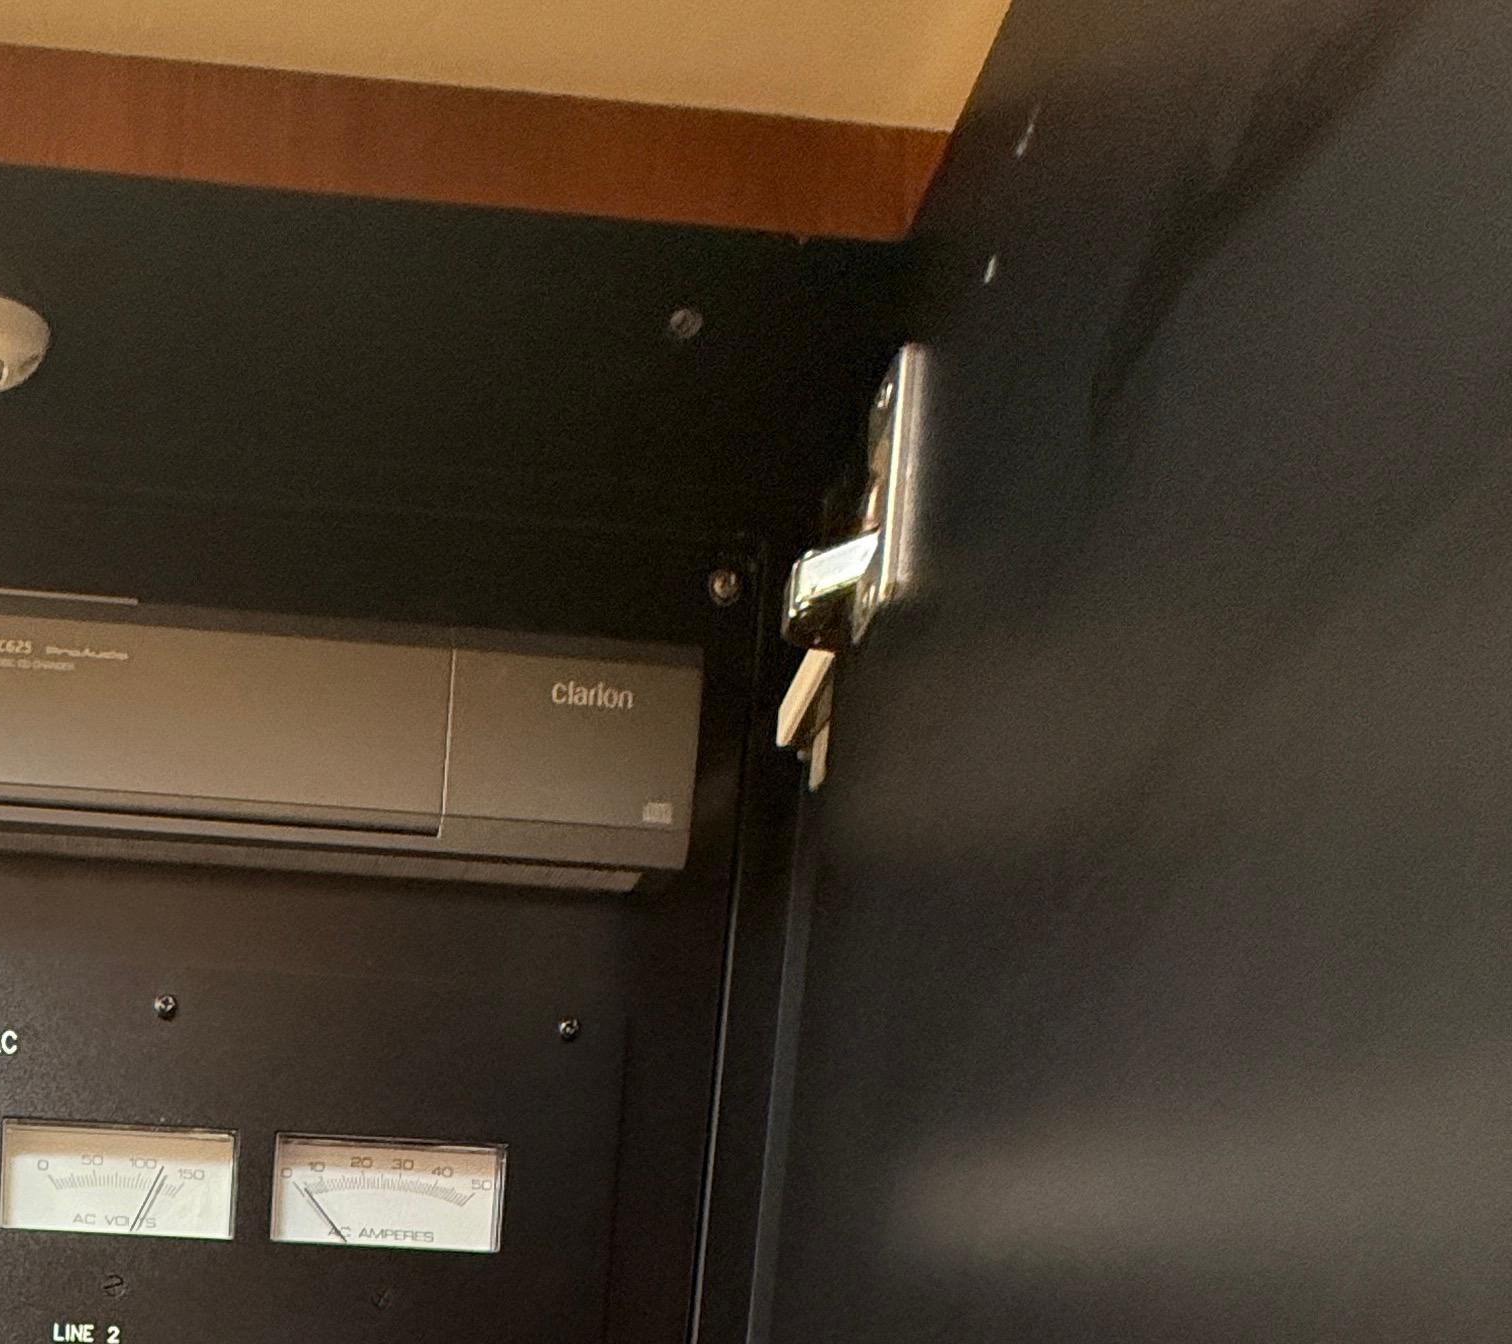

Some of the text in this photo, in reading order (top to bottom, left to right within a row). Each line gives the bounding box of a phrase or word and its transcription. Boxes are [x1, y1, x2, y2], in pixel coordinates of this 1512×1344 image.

[38, 1155, 205, 1180] 0 50 100 150
[281, 1157, 492, 1191] 0 10 20 30 40 50
[53, 1323, 120, 1344] LINE 2
